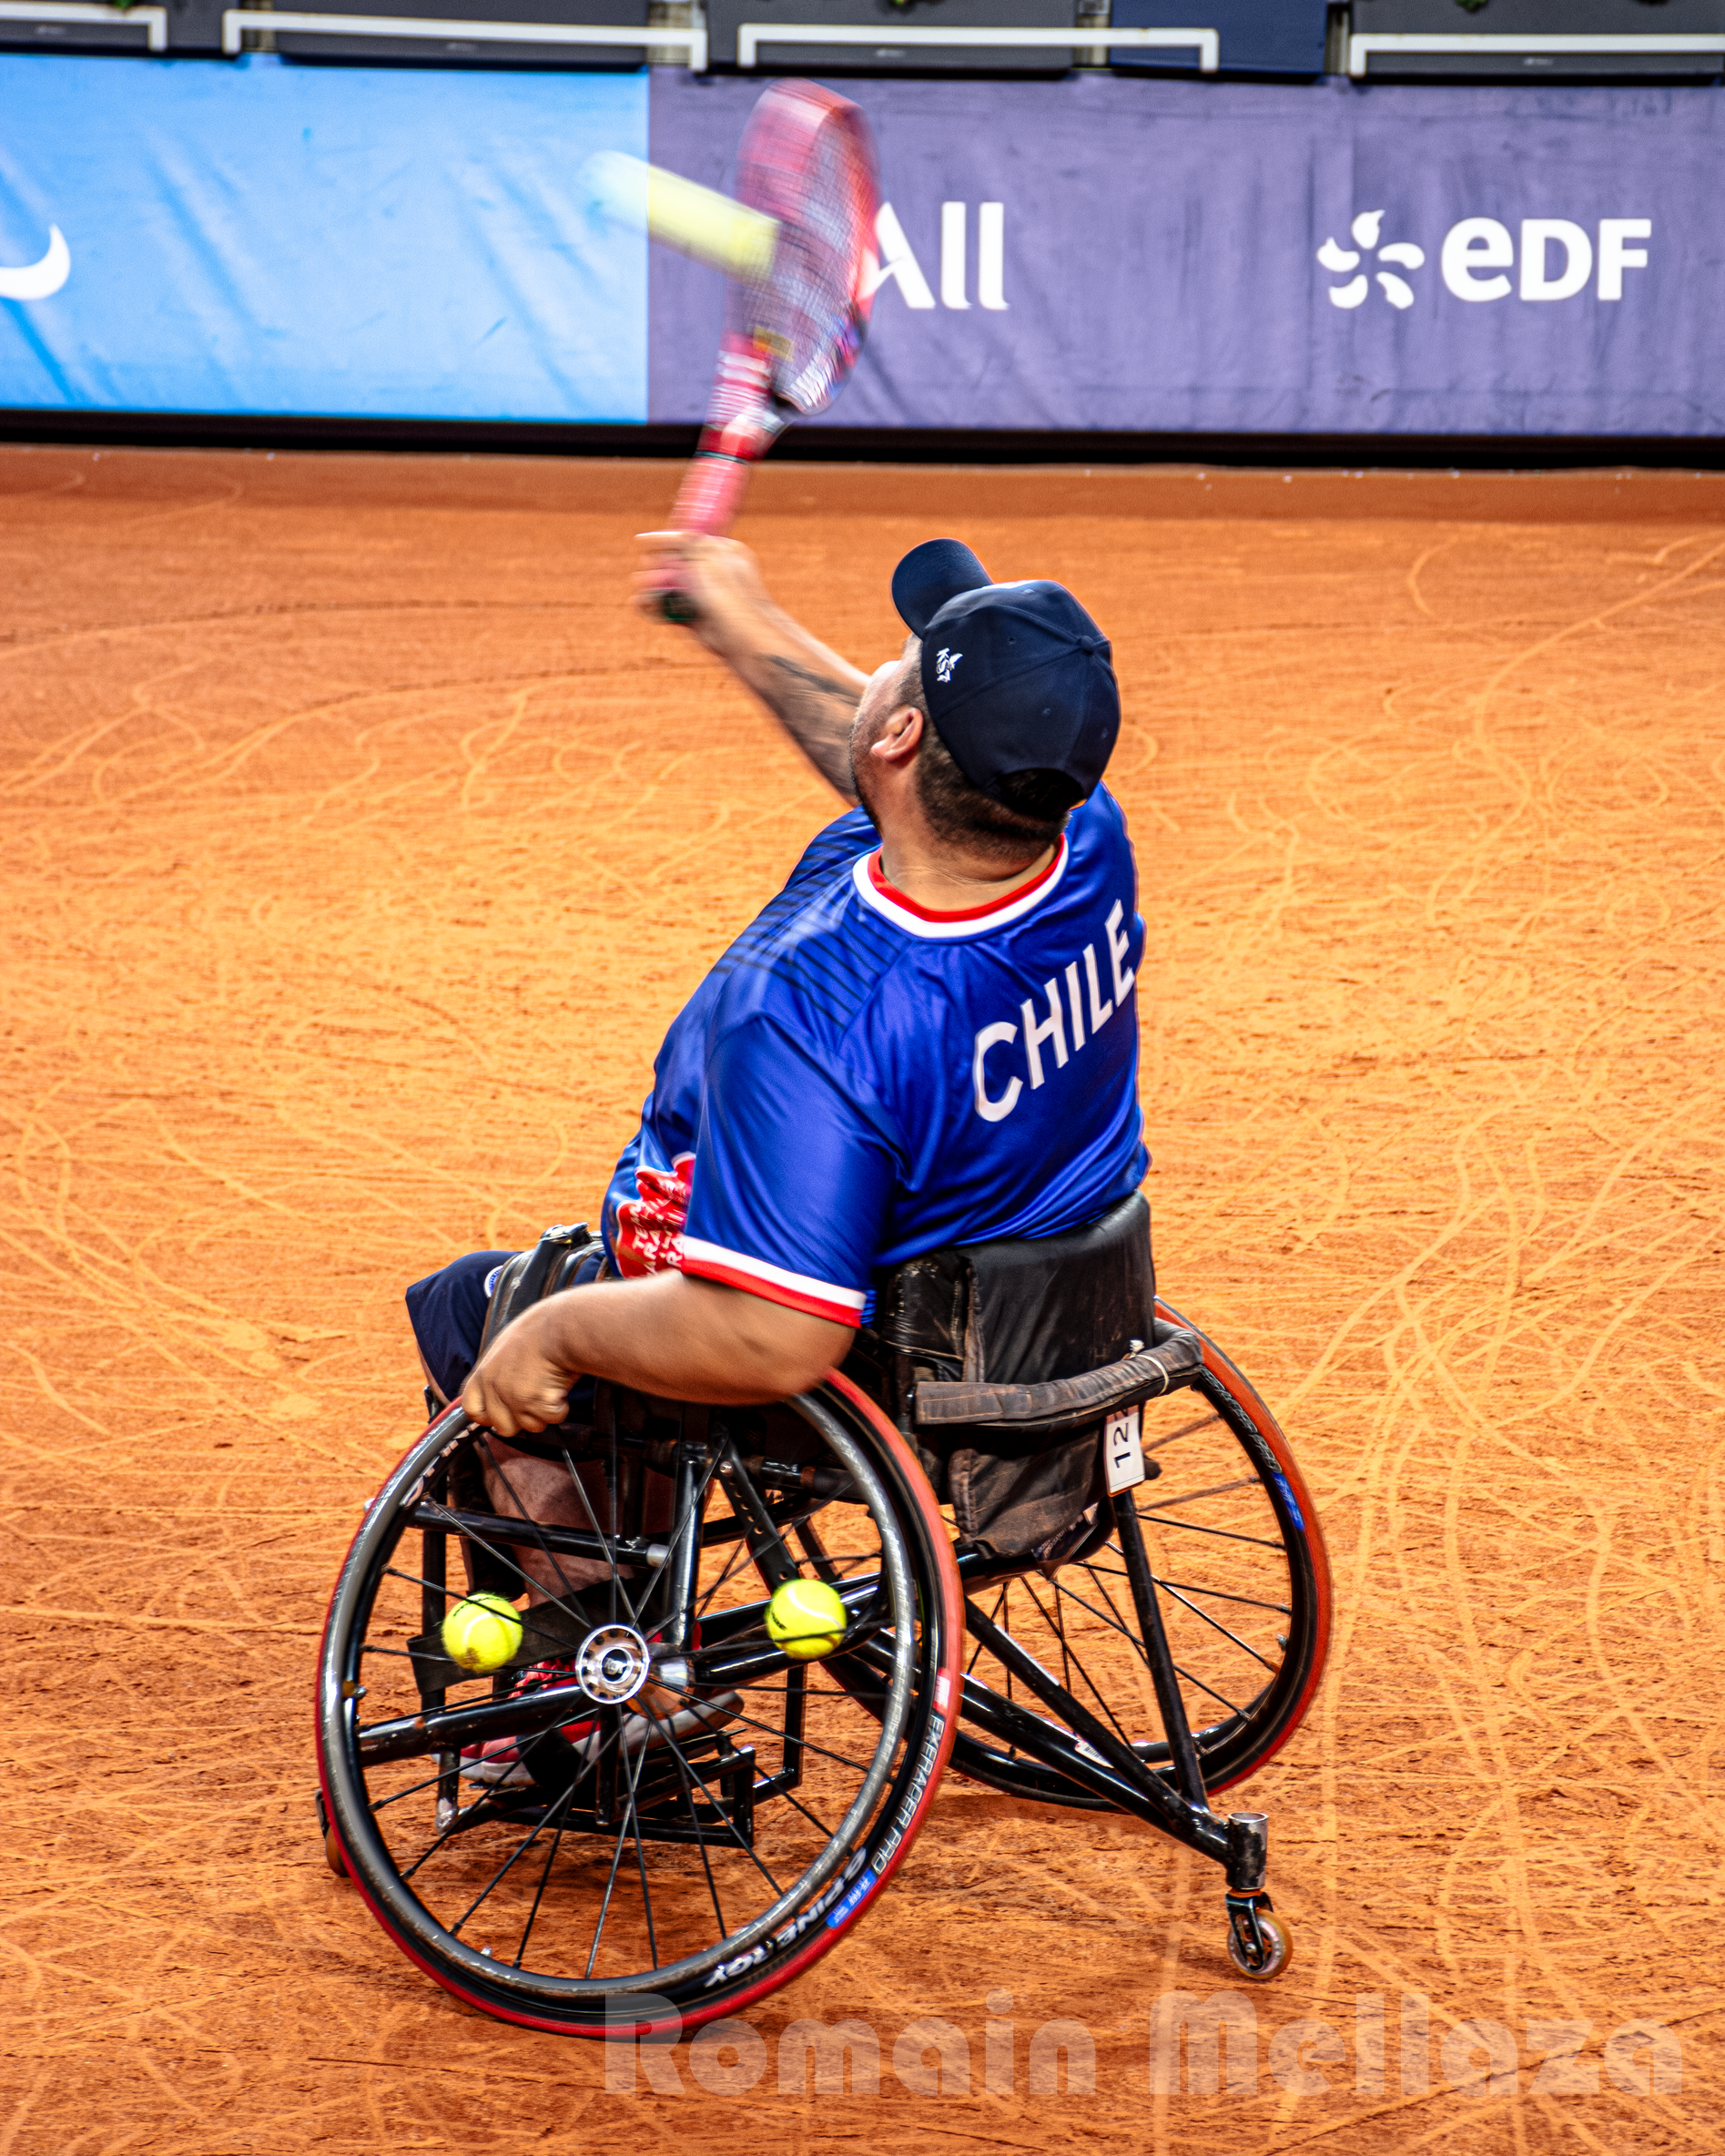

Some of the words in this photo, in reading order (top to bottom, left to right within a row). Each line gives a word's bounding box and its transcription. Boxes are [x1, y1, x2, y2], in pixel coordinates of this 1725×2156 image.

[972, 899, 1135, 1123] CHILE
[1113, 1422, 1131, 1469] 12
[871, 1825, 903, 1876] PRO
[704, 1846, 867, 1988] SPINERGY
